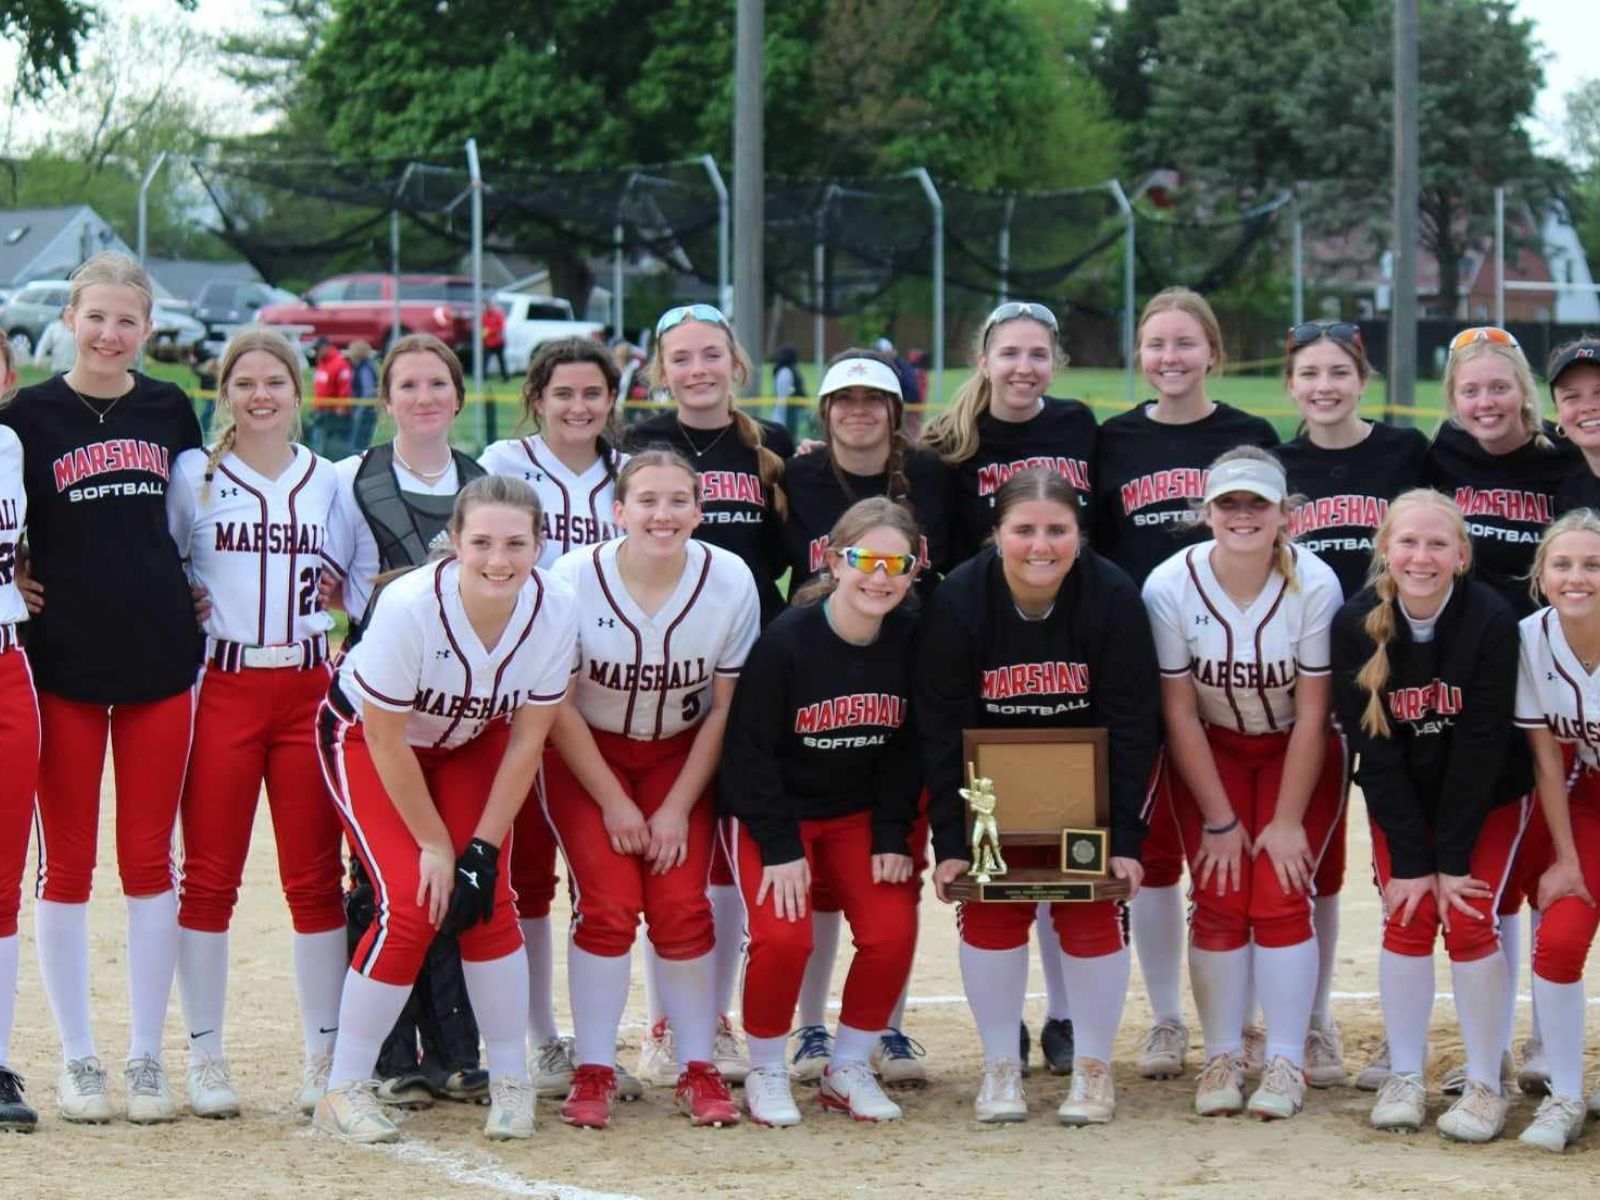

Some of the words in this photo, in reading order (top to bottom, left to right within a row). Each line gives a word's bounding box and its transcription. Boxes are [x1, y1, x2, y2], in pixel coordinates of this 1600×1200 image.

[53, 439, 170, 493] MARSHALL
[69, 481, 164, 502] SOFTBALL
[694, 470, 768, 508] SHAL
[1121, 467, 1210, 517] MARSH
[540, 512, 628, 545] ARSHA
[700, 511, 764, 524] TBALL
[1287, 494, 1388, 538] MARSHAL
[1463, 521, 1545, 543] SOFTBAL
[1299, 538, 1377, 553] OFTBA
[299, 566, 321, 617] 2
[589, 657, 709, 692] MARSHALL
[1190, 655, 1299, 689] MARSHAL
[412, 687, 520, 722] MARSHAL
[795, 693, 908, 734] MARSHAL
[986, 698, 1091, 717] SOFTBALL
[803, 735, 888, 750] SOFTBAL
[1544, 712, 1600, 743] MARS
